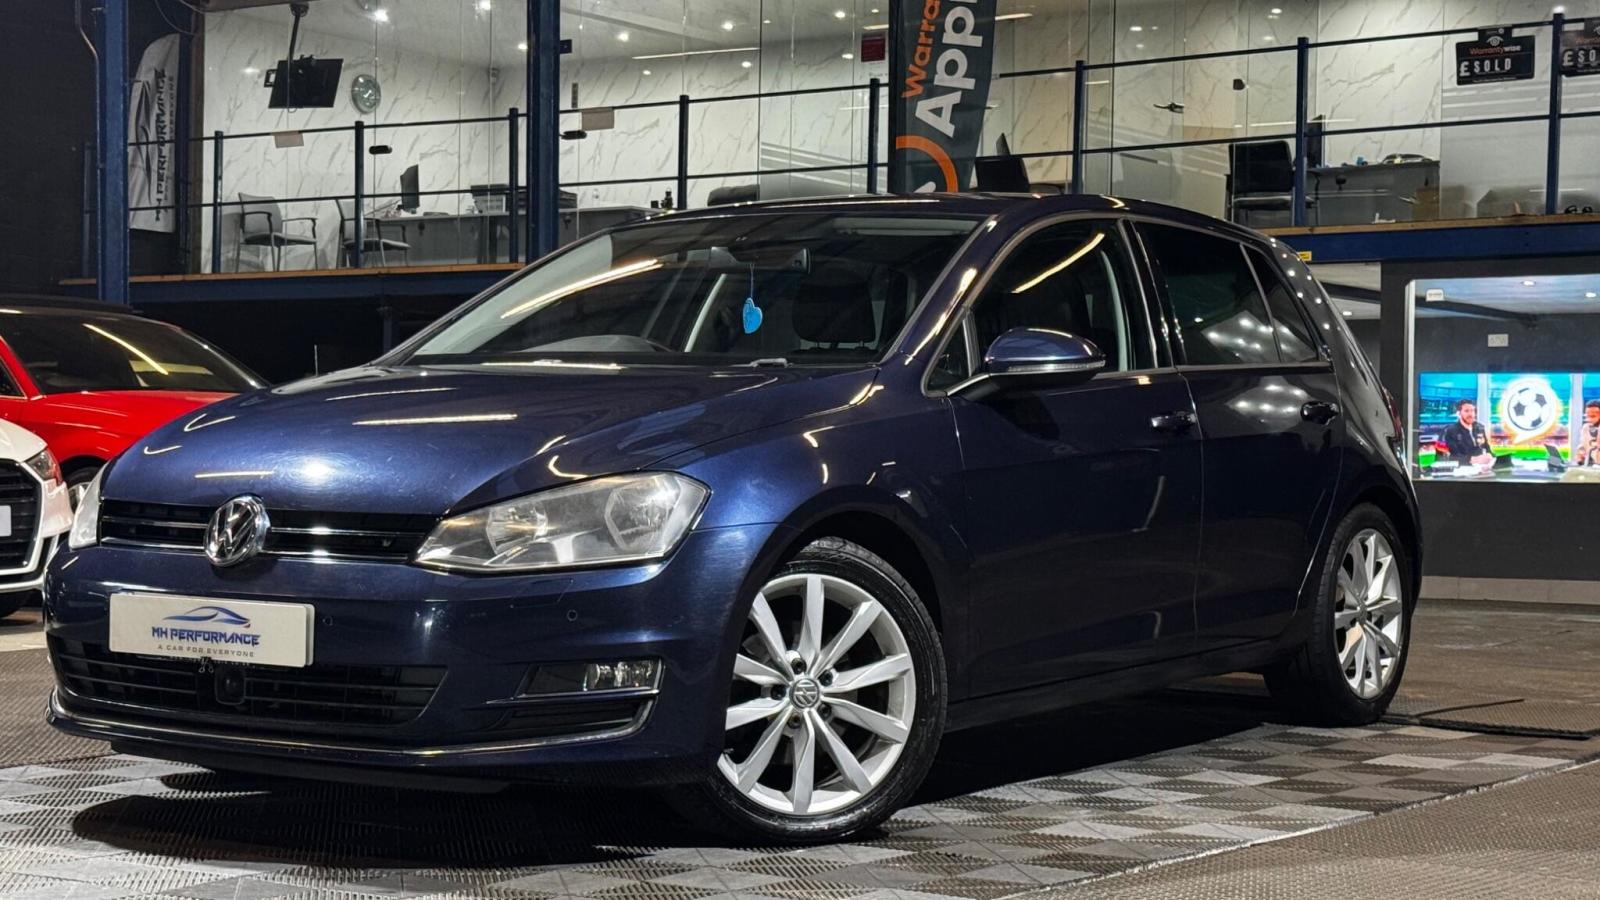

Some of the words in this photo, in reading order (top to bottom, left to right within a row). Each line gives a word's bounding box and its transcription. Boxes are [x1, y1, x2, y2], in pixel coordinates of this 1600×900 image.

[915, 0, 984, 138] App
[1473, 58, 1511, 73] SOLD
[151, 626, 168, 639] MH
[170, 627, 261, 648] PERFORMANCE
[186, 645, 204, 653] FOR
[206, 647, 255, 658] EVERYONE
